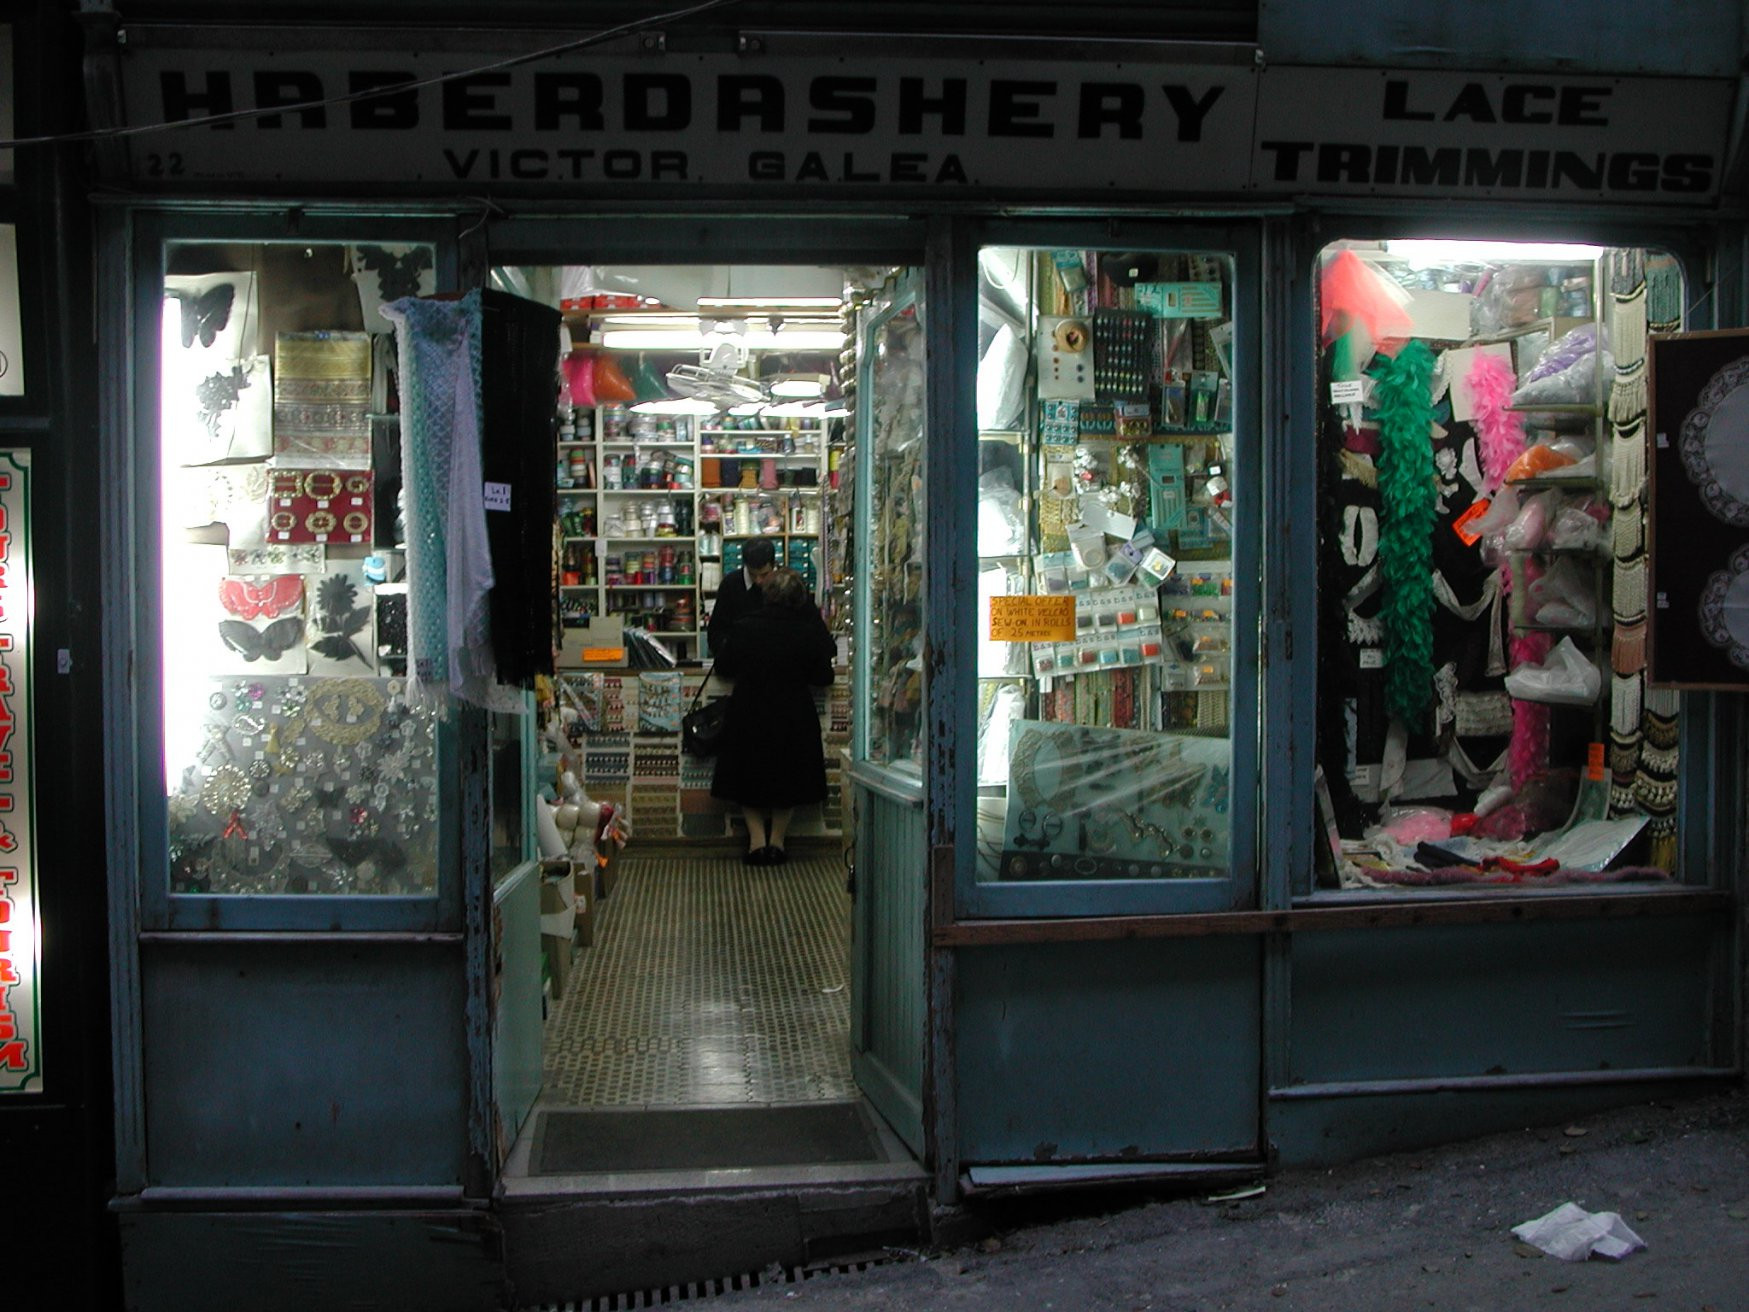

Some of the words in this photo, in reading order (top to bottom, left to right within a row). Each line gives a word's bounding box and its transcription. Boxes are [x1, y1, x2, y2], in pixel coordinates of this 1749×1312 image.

[160, 71, 1226, 142] HABERDASHERY
[1383, 81, 1613, 126] LACE
[147, 152, 185, 176] 22
[443, 148, 689, 180] VICTOR
[747, 151, 969, 184] GALEA
[1261, 141, 1714, 192] TRIMMINGS
[991, 596, 1032, 607] SPECIAL
[1035, 596, 1070, 607] OFFER
[991, 607, 1002, 616] ON
[1007, 607, 1034, 617] WHITE
[1038, 607, 1070, 617] VELCRO
[991, 628, 1002, 637] OF
[1032, 618, 1041, 627] IN
[1044, 618, 1072, 627] ROLLS
